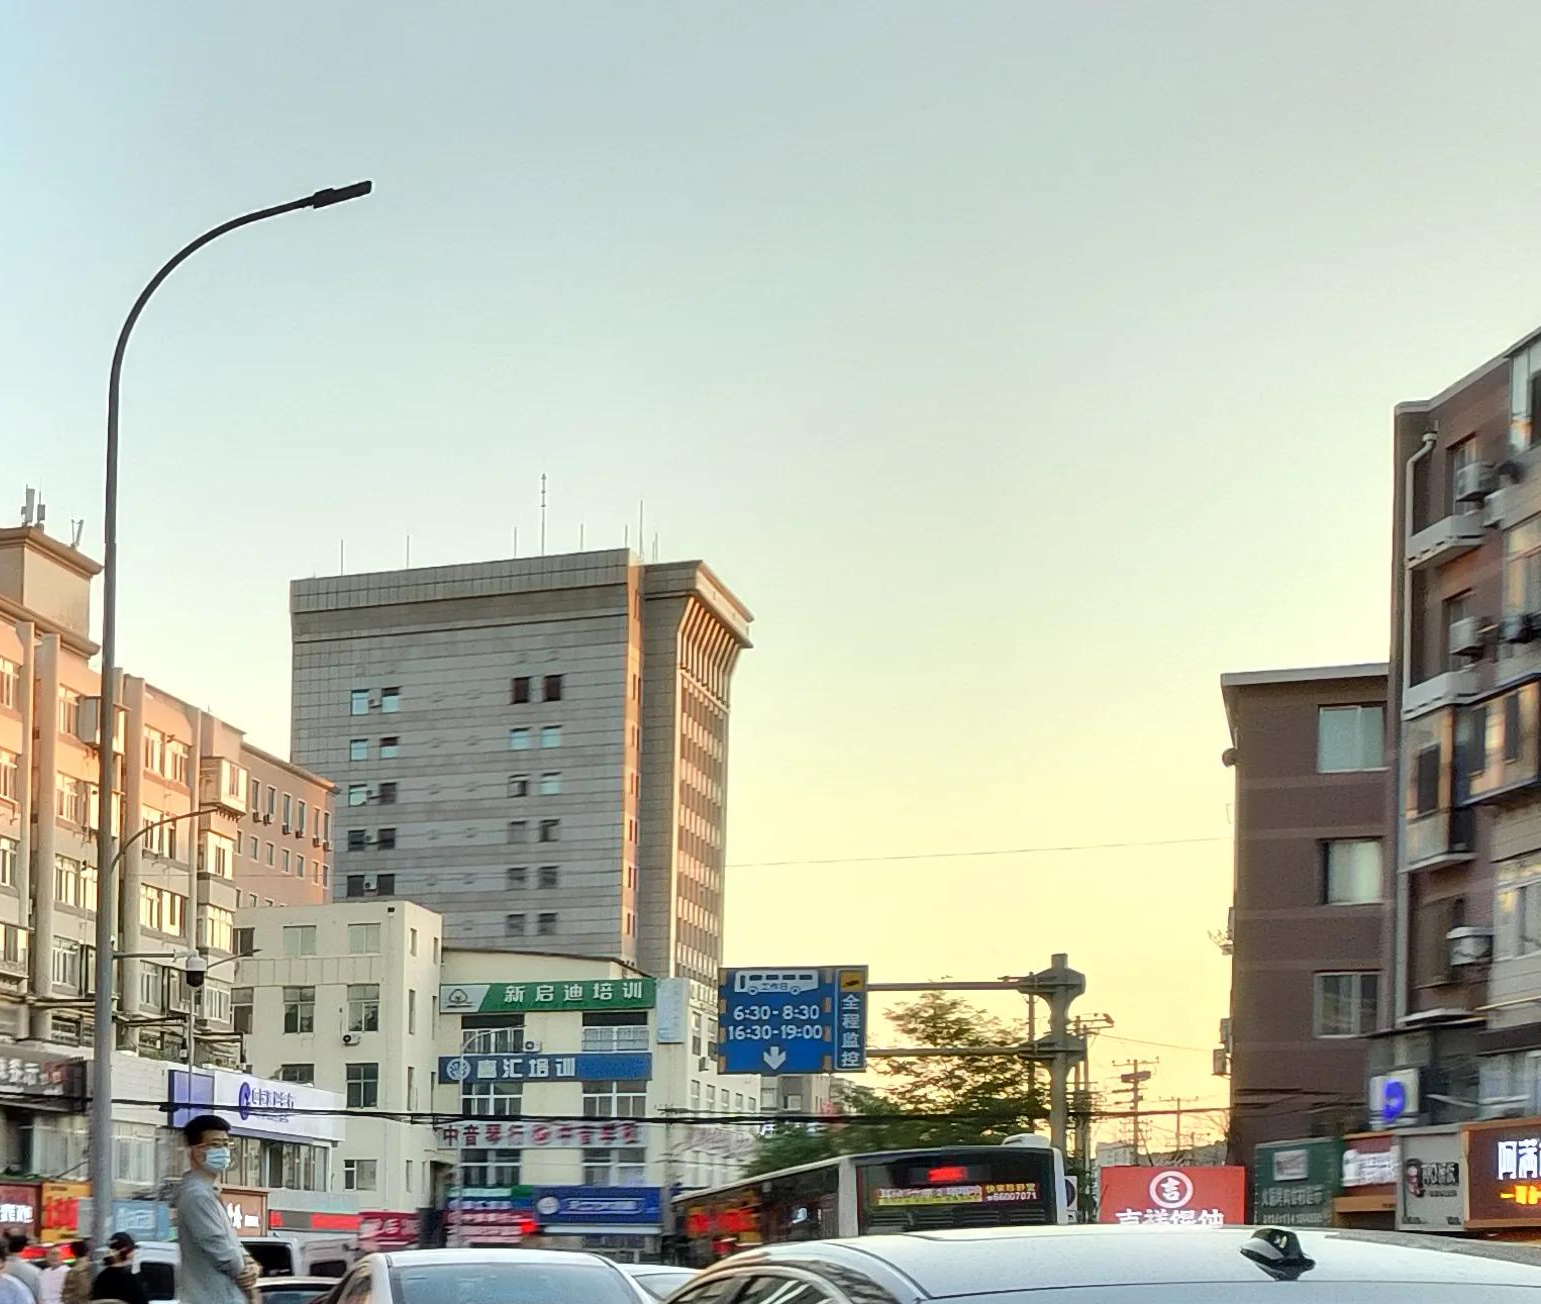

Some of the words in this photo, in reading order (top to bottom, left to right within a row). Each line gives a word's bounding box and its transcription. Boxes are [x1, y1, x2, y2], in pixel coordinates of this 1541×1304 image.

[504, 982, 643, 1003] 新启迪培训
